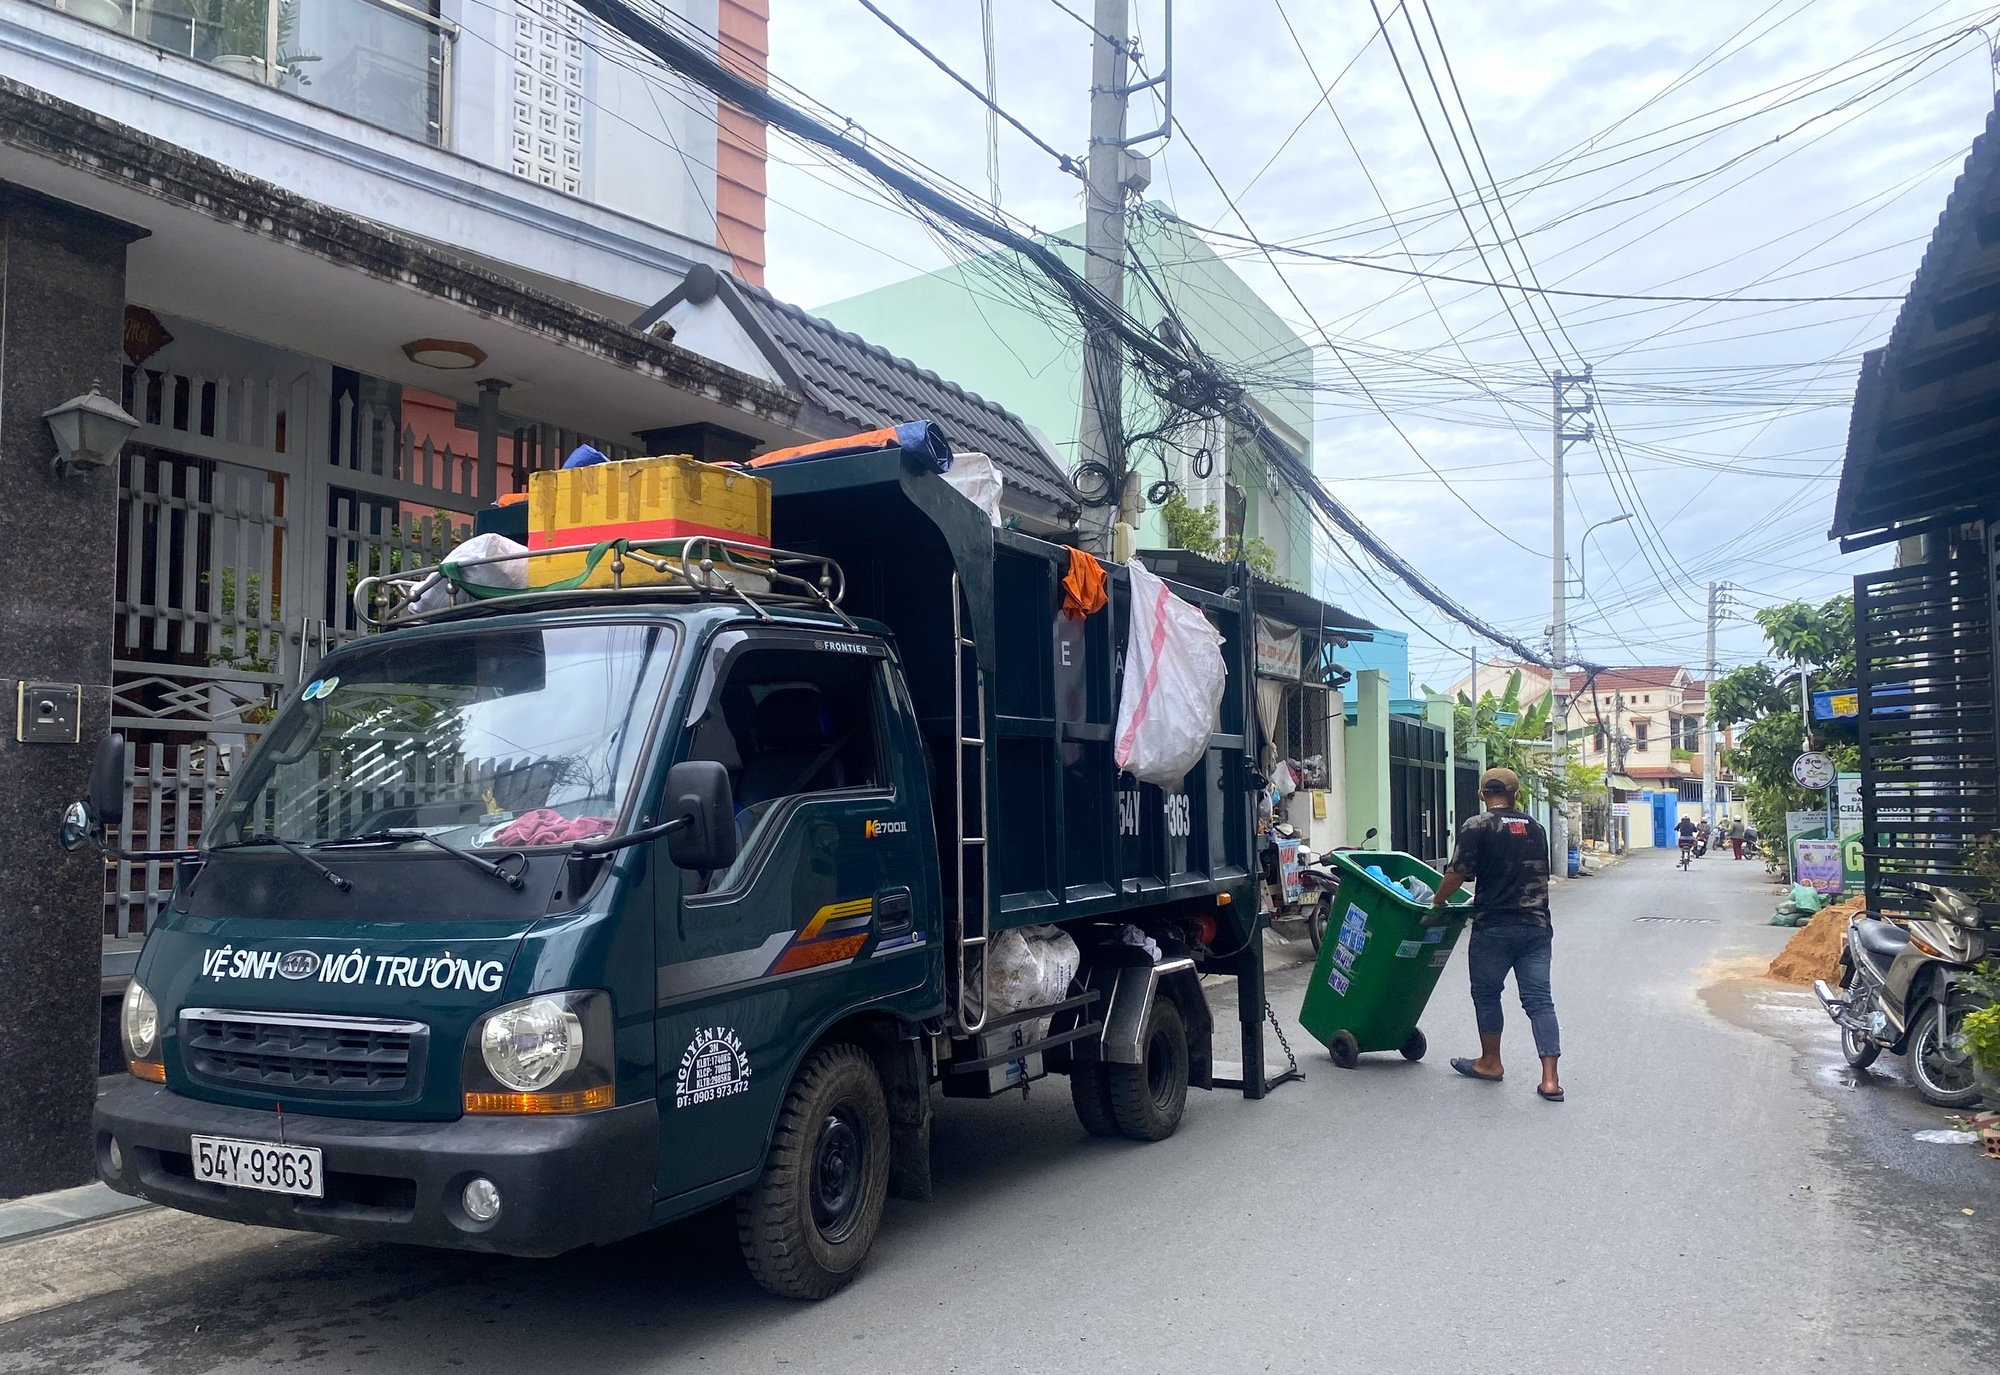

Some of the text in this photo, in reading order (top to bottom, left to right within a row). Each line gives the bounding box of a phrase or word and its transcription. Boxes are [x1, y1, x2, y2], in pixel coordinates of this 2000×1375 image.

[824, 641, 868, 653] FRONTIER
[1118, 790, 1141, 836] 54Y
[865, 819, 908, 838] K2700II
[202, 944, 503, 992] VỆ SINH MÔI TRƯỜNG
[282, 955, 313, 972] KIA
[709, 1042, 719, 1054] 3N
[676, 1026, 713, 1096] NGUYỄN
[716, 1026, 742, 1052] VĂN
[677, 1080, 749, 1109] ĐT: 0903 973.472
